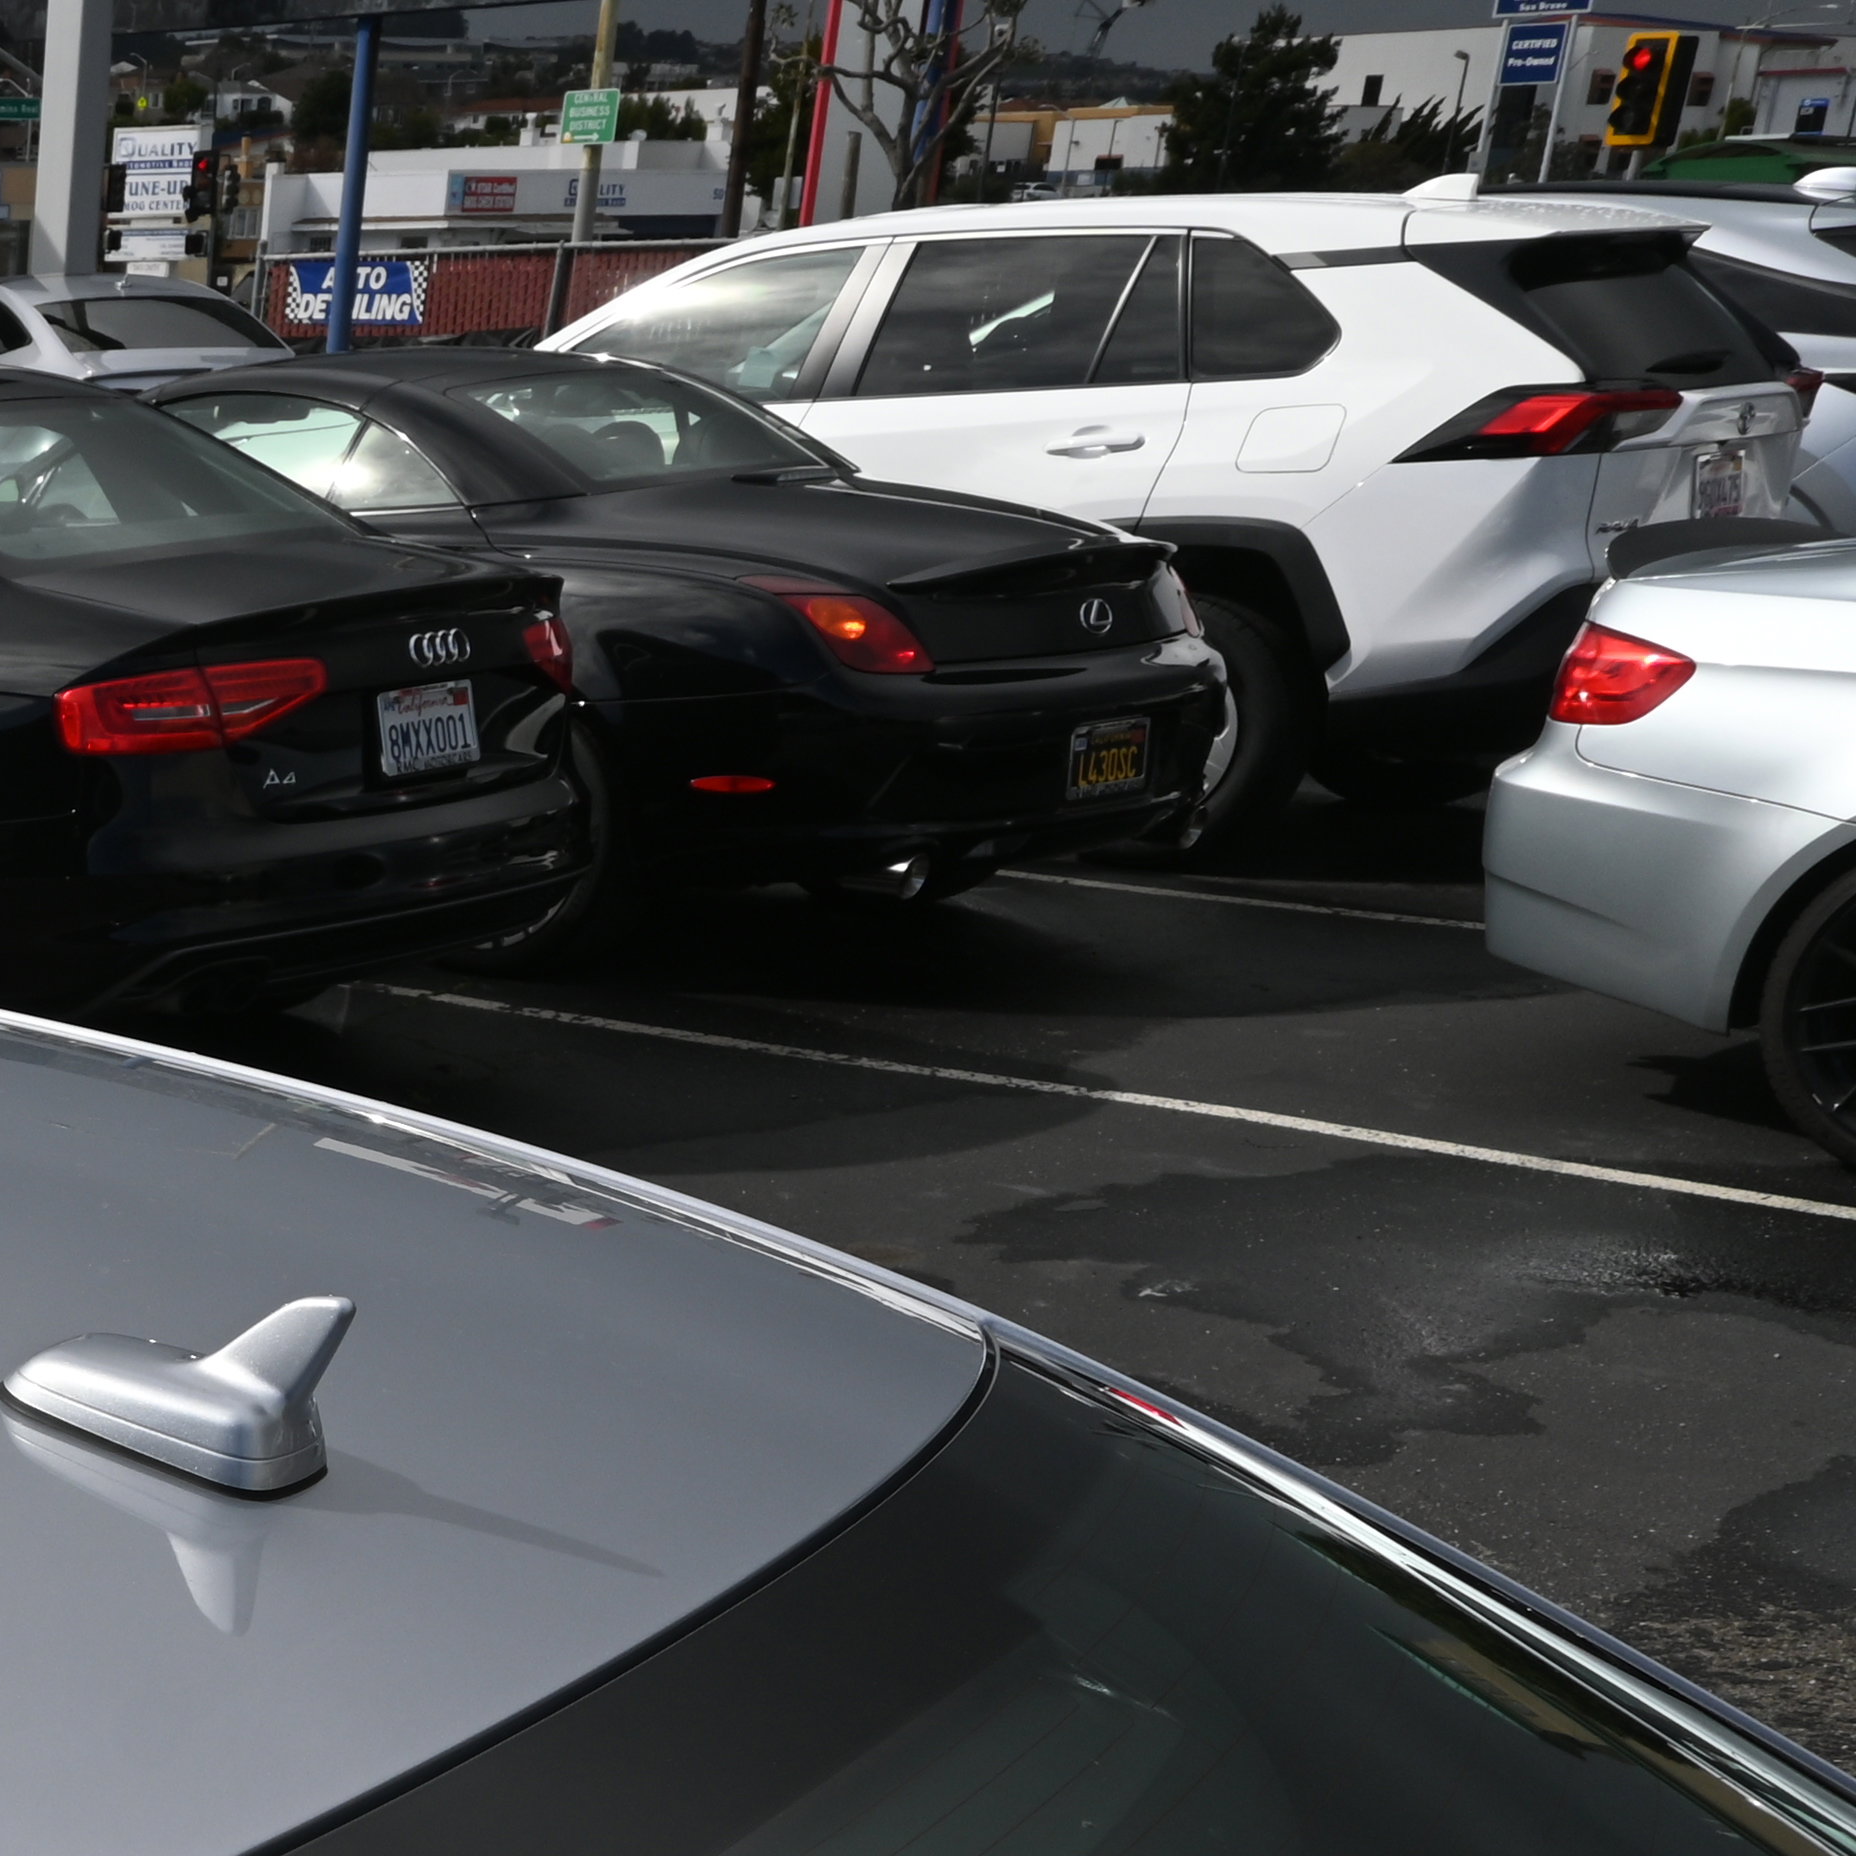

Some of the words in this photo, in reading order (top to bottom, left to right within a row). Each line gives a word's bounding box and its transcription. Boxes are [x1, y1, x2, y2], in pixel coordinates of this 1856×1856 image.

[1512, 39, 1558, 50] CERTIFIED
[1507, 56, 1556, 67] Pre-Owned
[569, 106, 610, 117] BUSINESS
[569, 119, 606, 131] DISTRICT
[119, 137, 197, 158] QUALITY
[128, 180, 188, 196] UNE-UP
[569, 179, 625, 196] QLITY
[322, 266, 387, 290] ATO
[298, 293, 412, 320] DEILING
[389, 713, 471, 763] 8MXX001
[1079, 746, 1138, 788] L430SC
[263, 768, 296, 789] A4
